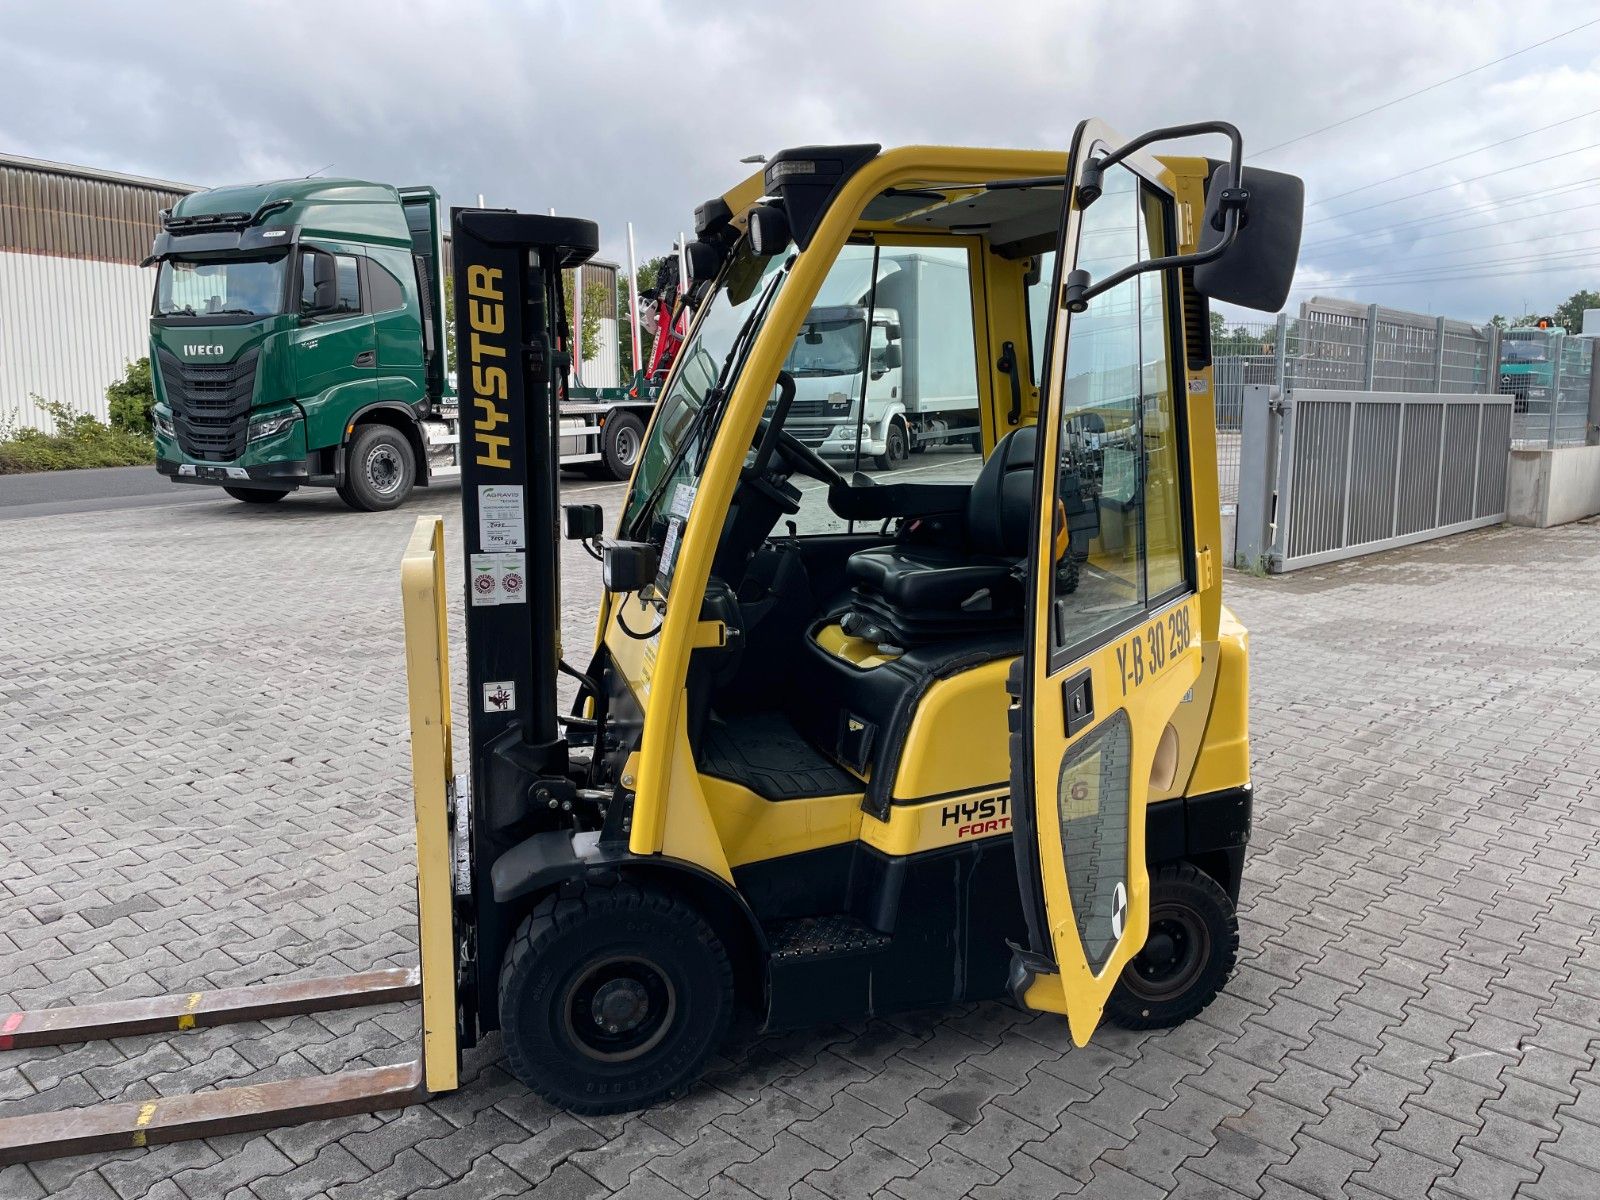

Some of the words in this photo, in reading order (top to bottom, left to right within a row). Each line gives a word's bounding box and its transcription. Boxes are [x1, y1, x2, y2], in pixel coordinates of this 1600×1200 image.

[183, 345, 224, 356] IVECO
[468, 265, 510, 469] HYSTER
[1116, 636, 1144, 697] Y-B
[1147, 621, 1165, 675] 30
[1168, 605, 1190, 660] 298
[941, 795, 1011, 827] HYST
[958, 817, 1011, 838] FORT
